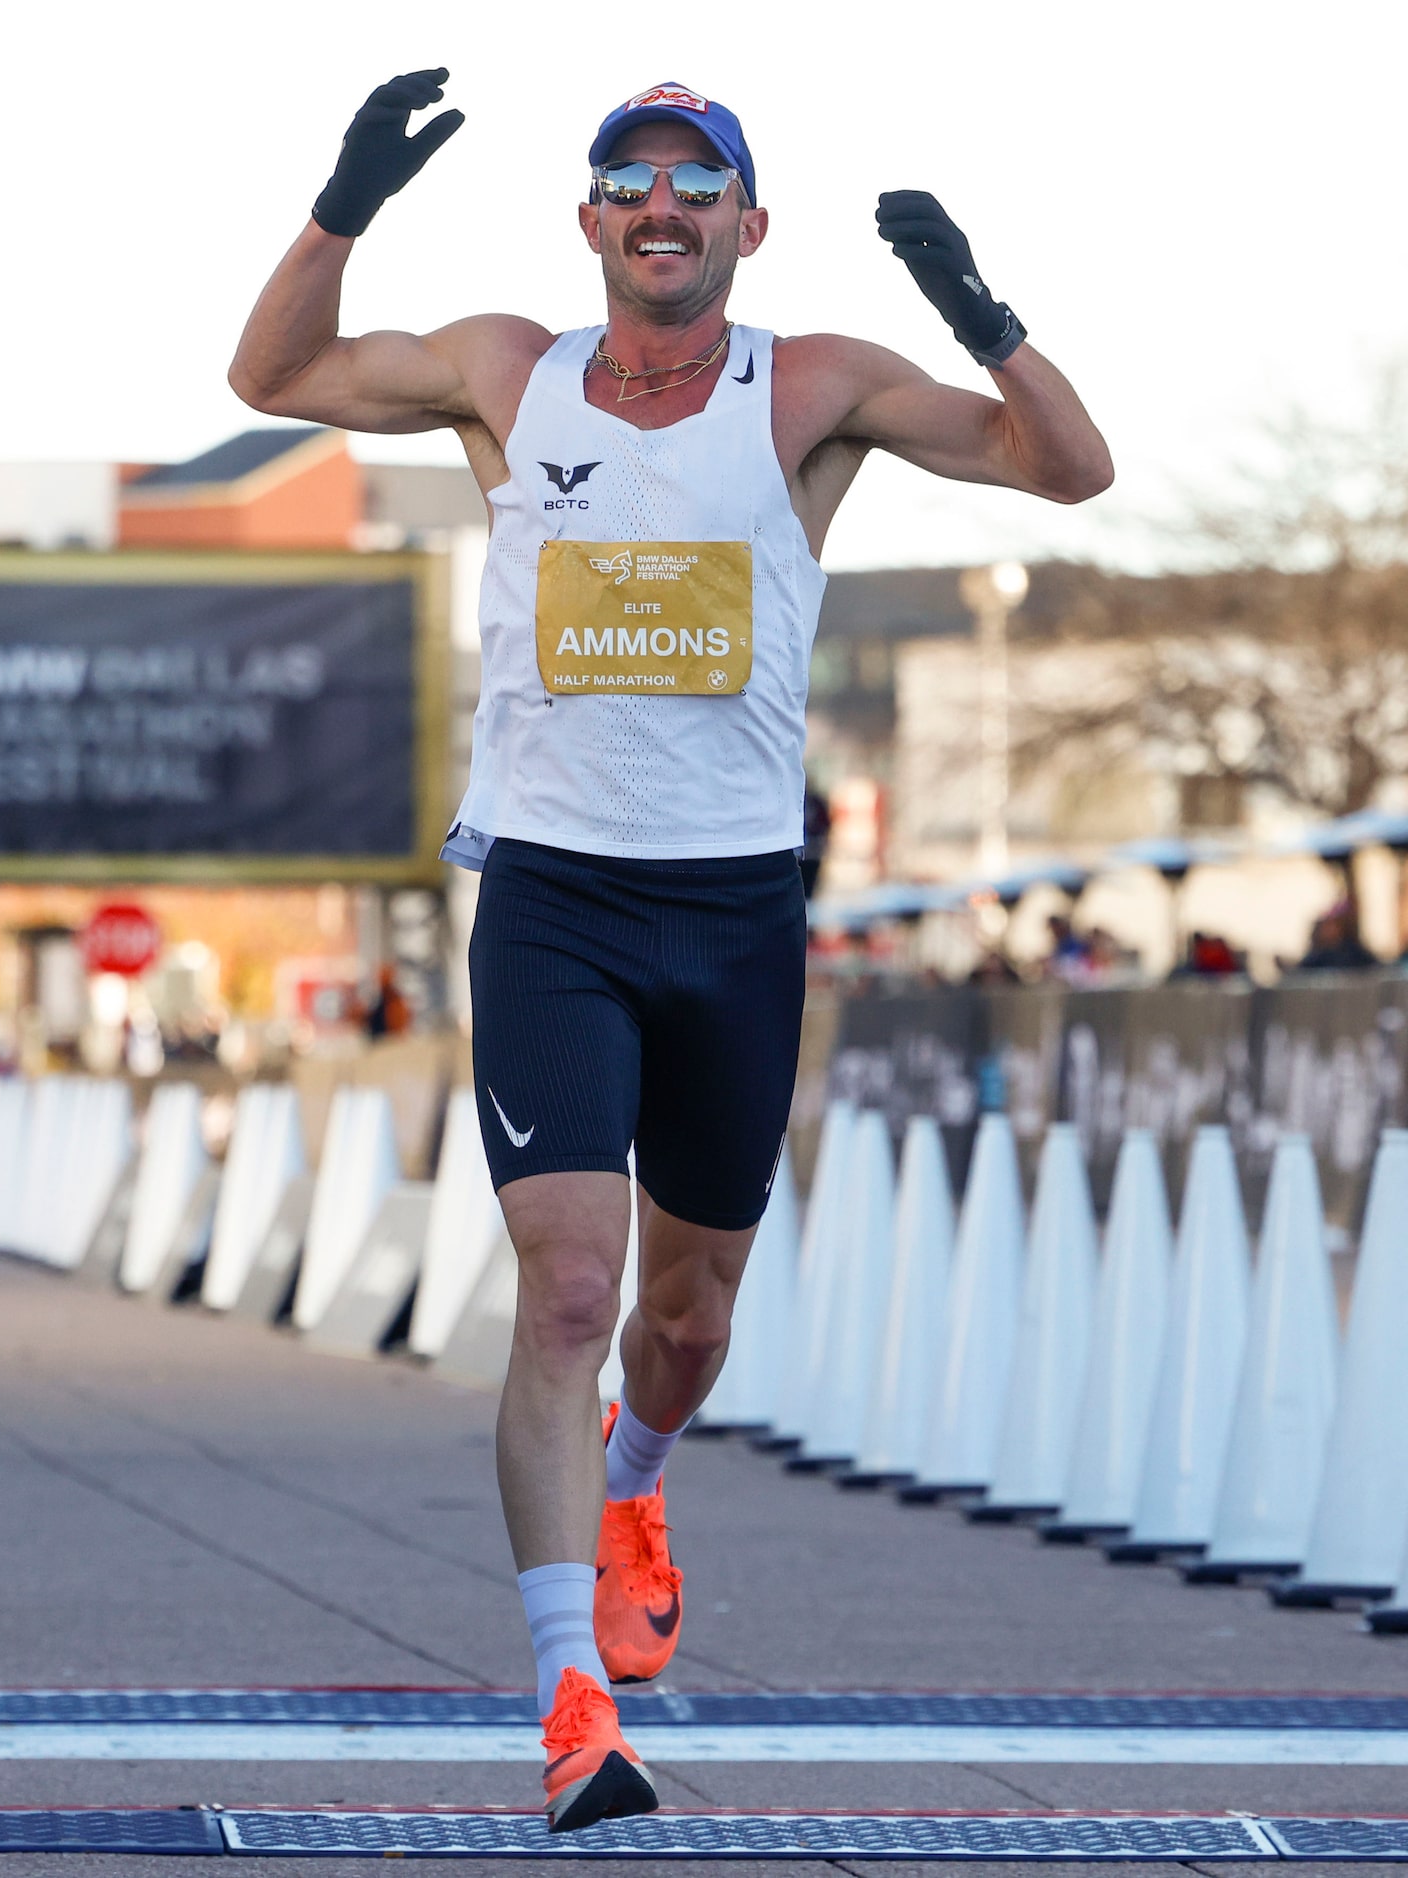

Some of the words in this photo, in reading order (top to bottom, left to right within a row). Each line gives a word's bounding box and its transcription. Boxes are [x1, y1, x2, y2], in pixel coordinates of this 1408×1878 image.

[544, 499, 589, 510] BCTC
[636, 555, 660, 564] BMW
[661, 555, 698, 564] DALLAS
[636, 564, 690, 572] MARATHON
[636, 572, 681, 580] FESTIVAL
[624, 603, 662, 614] ELITE
[555, 627, 731, 657] AMMONS
[739, 637, 747, 647] 41
[553, 674, 591, 686] HALF
[593, 674, 676, 686] MARATHON
